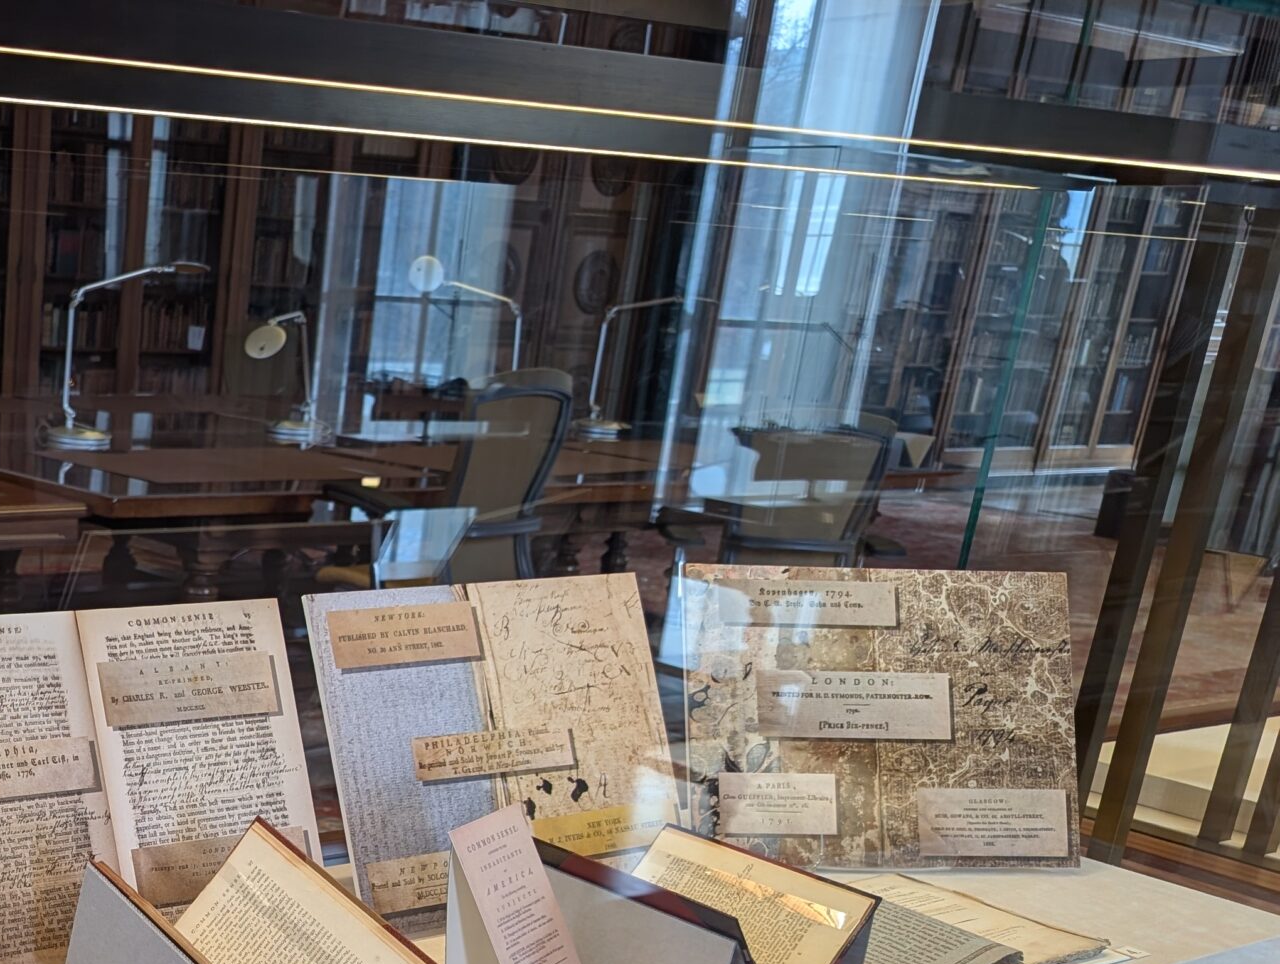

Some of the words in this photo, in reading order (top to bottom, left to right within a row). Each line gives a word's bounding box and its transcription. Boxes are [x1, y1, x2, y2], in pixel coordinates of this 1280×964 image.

[126, 615, 176, 627] COMMON
[337, 632, 376, 642] PUBLISHED
[392, 628, 420, 637] CALVIN
[811, 677, 893, 686] LONDON:
[122, 693, 154, 702] CHARLES
[173, 690, 185, 698] and
[190, 686, 223, 696] GEORGE
[800, 691, 813, 699] FOR
[830, 692, 864, 700] SYMONDS,
